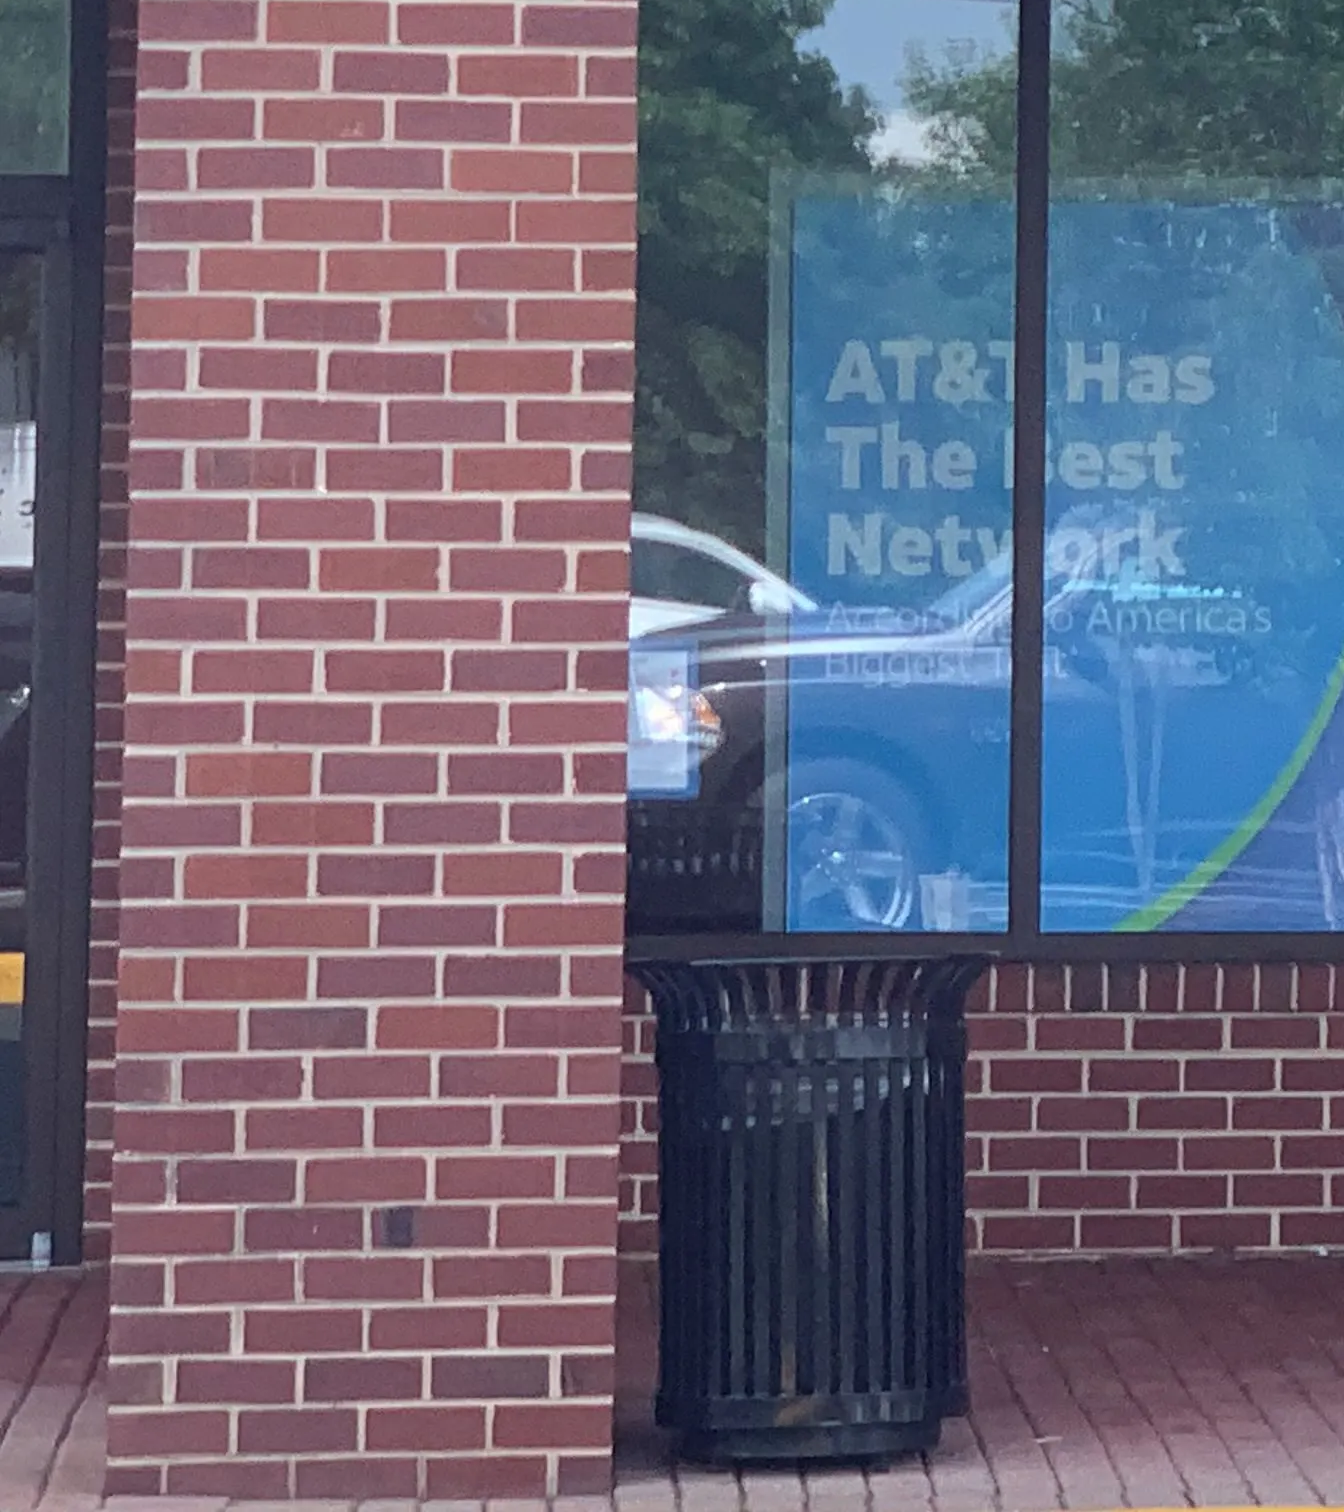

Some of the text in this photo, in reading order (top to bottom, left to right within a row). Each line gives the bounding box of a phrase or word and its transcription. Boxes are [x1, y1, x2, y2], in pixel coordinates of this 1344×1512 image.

[1066, 340, 1216, 405] Has
[826, 421, 978, 489] The
[1086, 598, 1273, 634] America's
